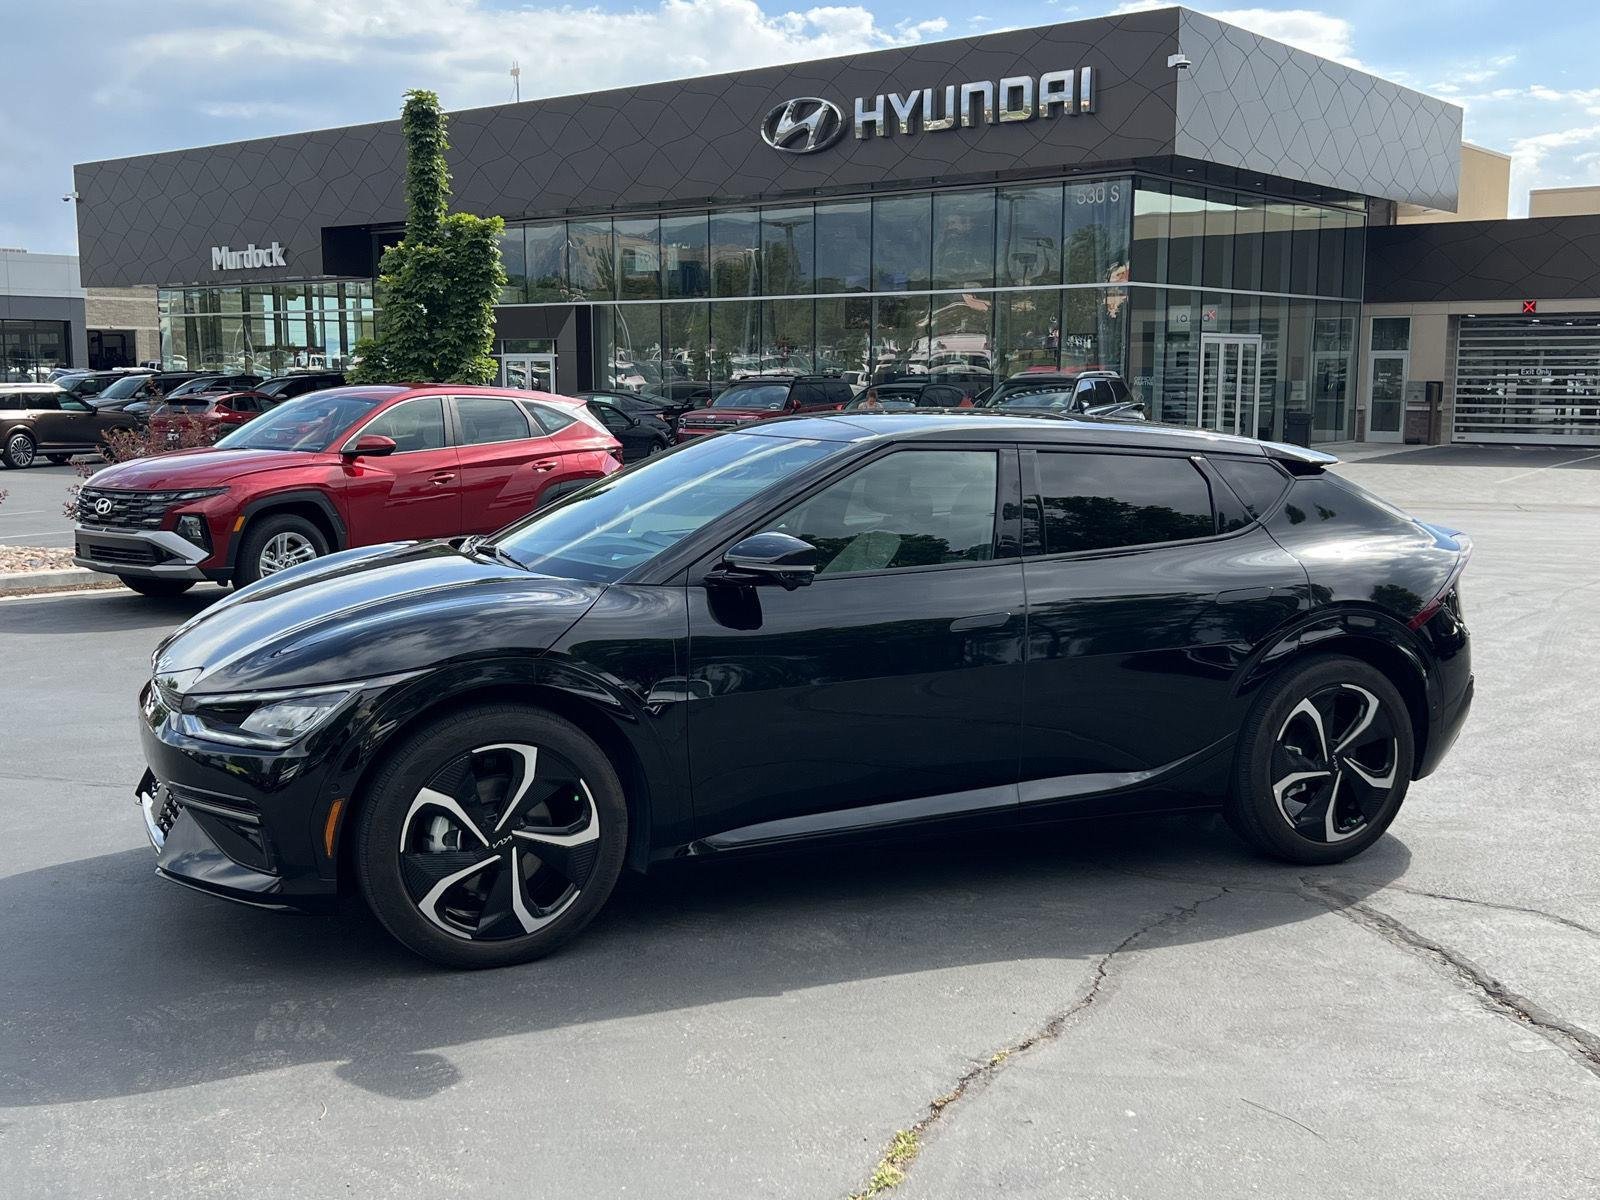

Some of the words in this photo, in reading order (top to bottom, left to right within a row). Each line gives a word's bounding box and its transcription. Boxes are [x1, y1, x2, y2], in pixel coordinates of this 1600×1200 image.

[854, 66, 1095, 140] HYUNDAI
[1077, 186, 1106, 205] 530
[1110, 184, 1120, 202] S
[211, 241, 287, 271] Murdock
[1520, 368, 1535, 376] Exit
[1536, 368, 1552, 377] Only
